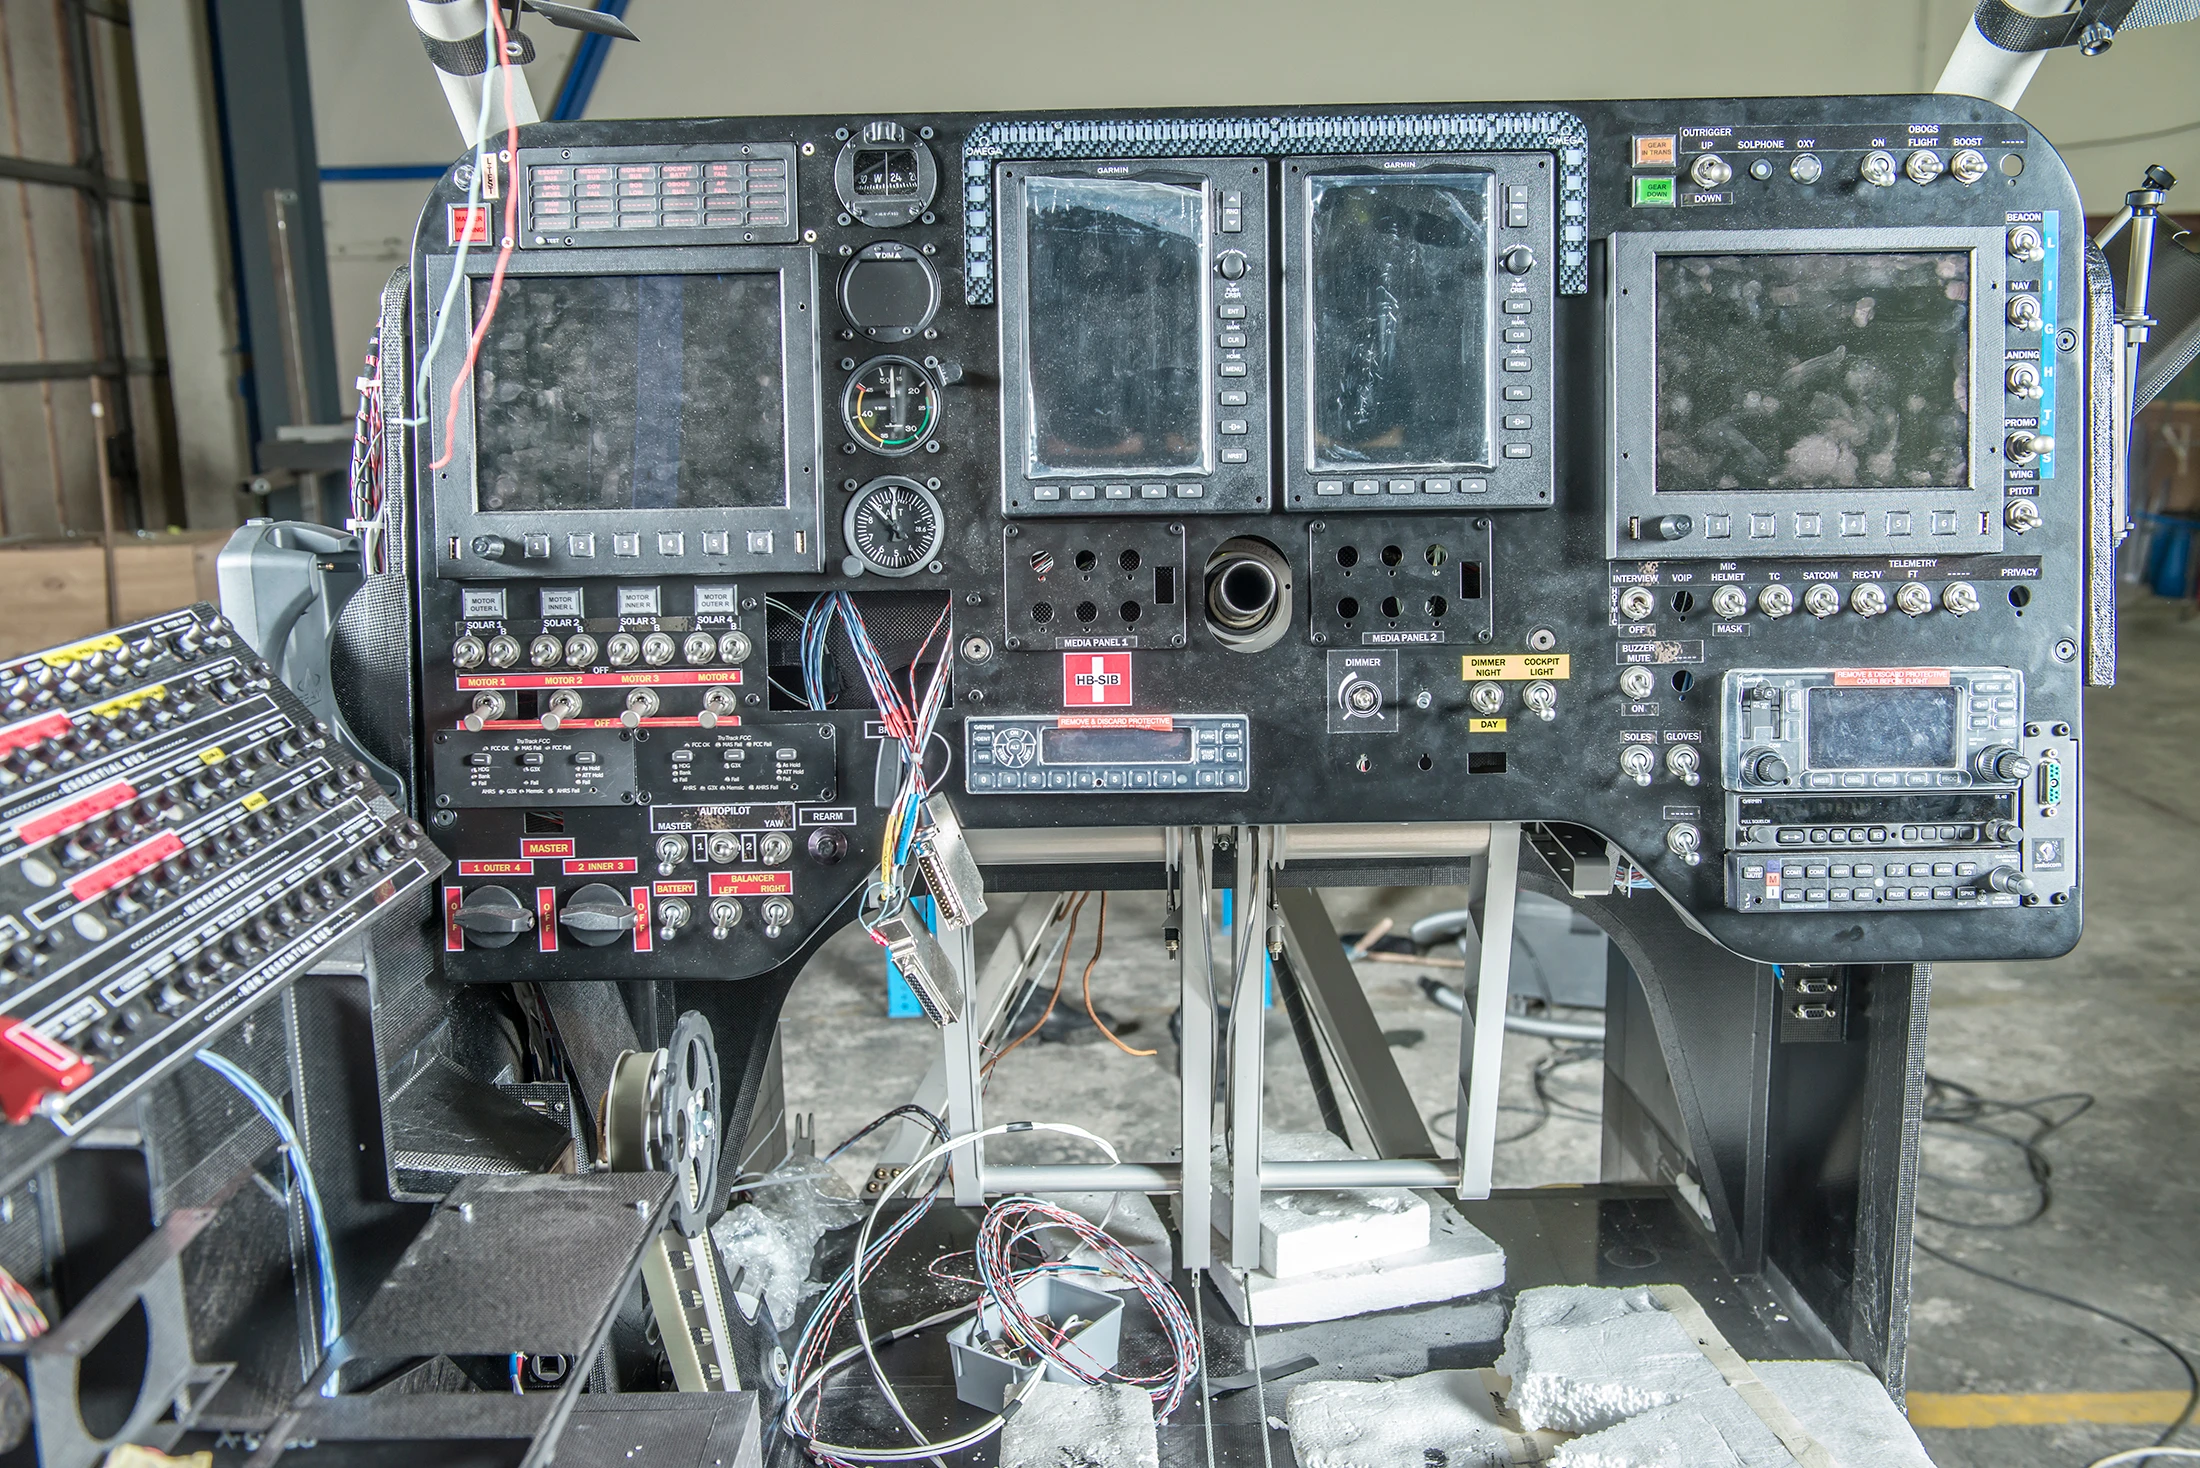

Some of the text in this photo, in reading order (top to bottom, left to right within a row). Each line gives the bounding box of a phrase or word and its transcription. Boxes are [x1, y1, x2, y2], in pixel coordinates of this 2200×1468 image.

[1683, 128, 1732, 137] OUTRIGGER
[1908, 126, 1939, 134] OBOGS
[1547, 136, 1584, 145] OMEGA
[1701, 140, 1815, 150] UP SOLPHONE OXY
[1872, 138, 1982, 147] ON FLIGHT BOOST
[966, 148, 1002, 156] OMEGA
[874, 173, 902, 184] W 24
[1694, 194, 1722, 203] DOWN
[2006, 213, 2042, 222] BEACON
[2012, 282, 2030, 290] NAV
[2005, 418, 2036, 426] PROMO
[2010, 470, 2033, 478] WING
[2010, 487, 2034, 496] PITOT
[1889, 560, 1937, 568] TELEMETRY
[1613, 574, 1658, 582] INTERVIEW
[1672, 574, 1692, 582] VOIP
[1712, 573, 1745, 581] HELMET
[1803, 572, 1838, 580] SATCOM
[2002, 568, 2038, 577] PRIVACY
[1064, 638, 1128, 647] MEDIA PANEL 1
[1372, 633, 1437, 643] MEDIA PANEL 2
[1346, 658, 1380, 666] DIMMER
[1471, 658, 1506, 666] DIMMER
[1524, 658, 1560, 666] COCKPIT
[1476, 668, 1501, 676] NIGHT
[1530, 668, 1554, 676] LIGHT
[1076, 674, 1118, 685] HB-SIB
[594, 719, 610, 728] OFF
[1480, 720, 1498, 728] DAY
[1666, 733, 1699, 741] GLOVES
[700, 806, 750, 816] AUTOPILOT
[813, 812, 844, 821] REARM
[658, 822, 692, 831] MASTER
[764, 819, 784, 828] YAW
[529, 842, 568, 853] MASTER
[697, 842, 704, 851] 1
[746, 842, 752, 851] 2
[474, 863, 520, 872] 1 OUTER 4
[578, 862, 624, 871] 2 INNER 3
[731, 874, 774, 884] BALANCER
[656, 884, 694, 894] BATTERY
[719, 884, 786, 894] LEFT RIGHT
[184, 884, 232, 917] MISSION
[238, 939, 314, 997] NON-ESSENTIAL
